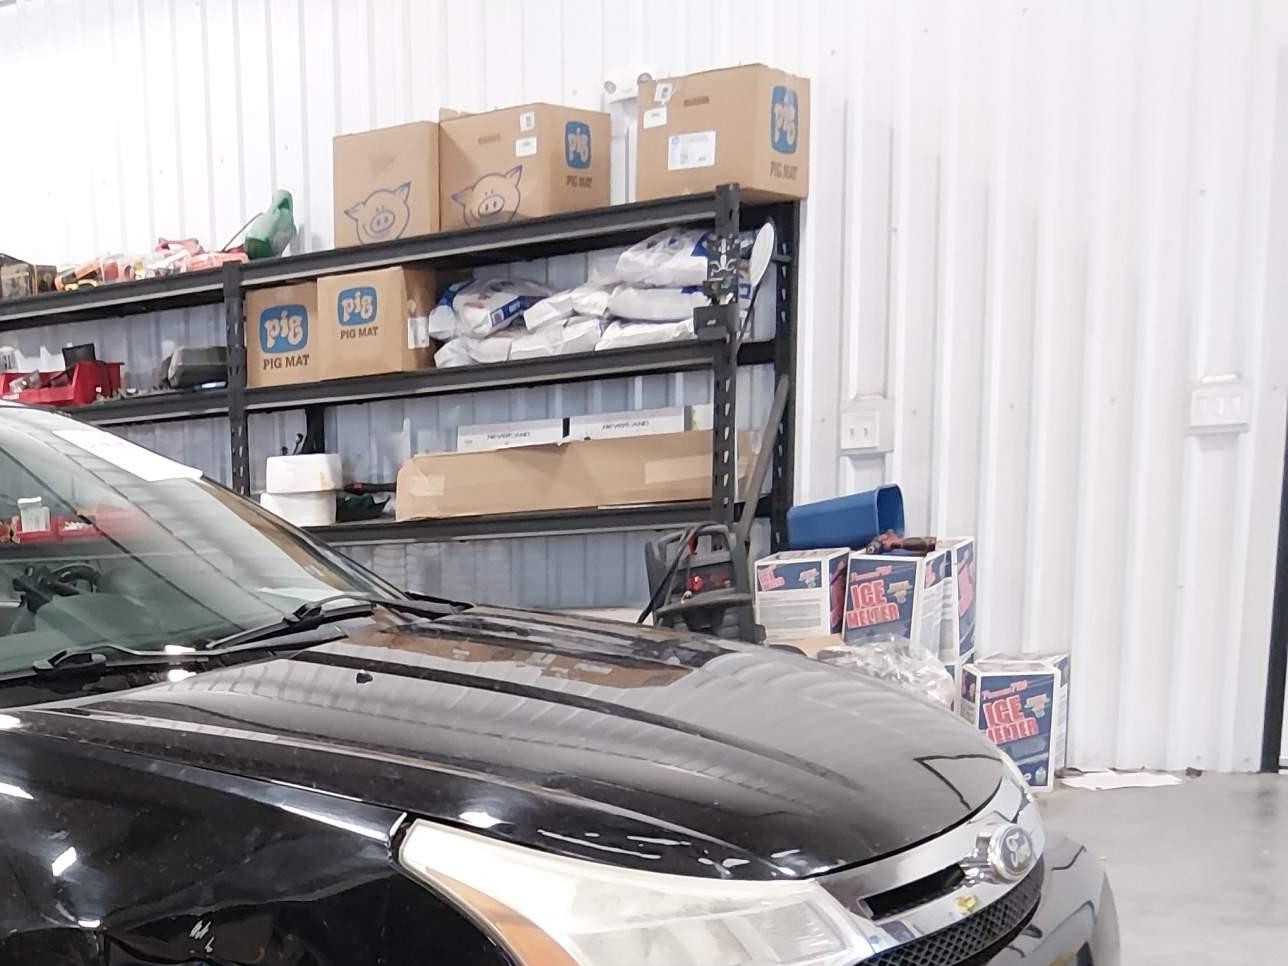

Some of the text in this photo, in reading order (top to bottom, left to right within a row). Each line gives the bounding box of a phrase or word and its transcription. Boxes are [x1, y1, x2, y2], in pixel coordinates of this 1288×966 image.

[341, 291, 373, 322] pig
[264, 309, 303, 349] pig
[340, 326, 379, 340] PIG MAT
[263, 354, 310, 370] PIG MAT
[850, 579, 889, 608] ICE
[847, 602, 900, 629] MELTER
[983, 694, 1025, 728] ICE
